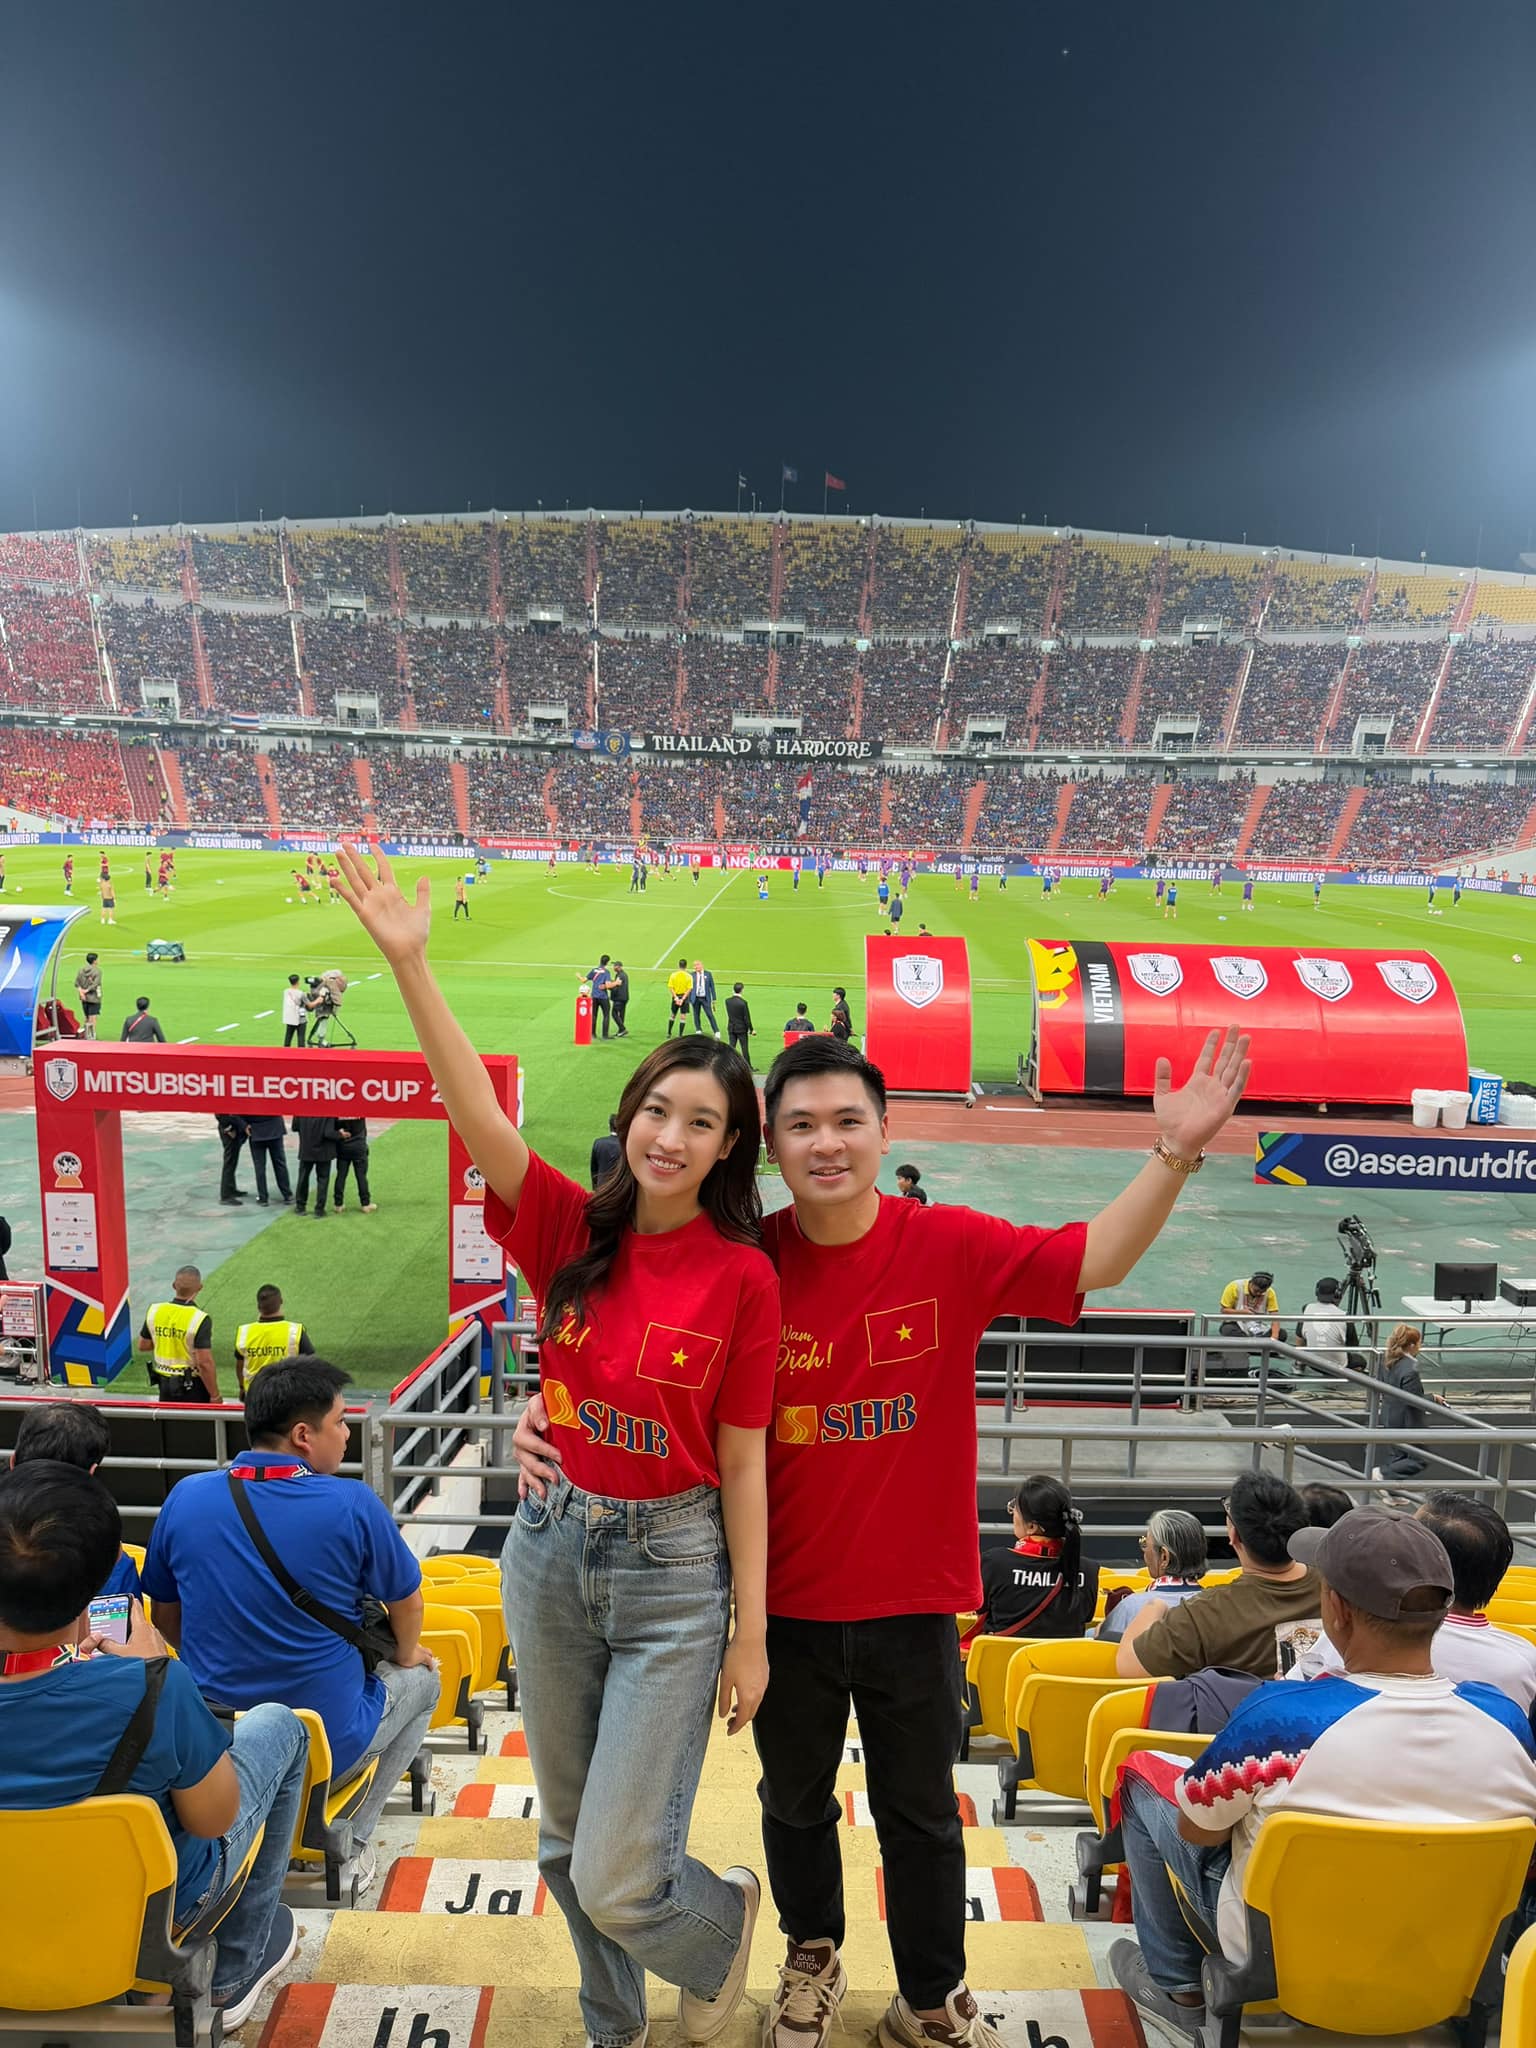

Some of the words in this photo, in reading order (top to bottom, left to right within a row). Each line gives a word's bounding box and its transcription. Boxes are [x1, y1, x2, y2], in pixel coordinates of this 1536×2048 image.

[651, 734, 751, 755] THAILAND
[775, 738, 873, 760] HARDCORE
[90, 833, 116, 845] ASEAN
[117, 834, 146, 846] UNITED
[146, 835, 157, 847] FC
[195, 837, 221, 848] ASEAN
[222, 838, 251, 849] UNITED
[251, 839, 263, 850] FC
[302, 841, 328, 852] ASEAN
[359, 843, 369, 854] FC
[408, 846, 434, 857] ASEAN
[435, 846, 464, 858] UNITED
[464, 847, 475, 858] FC
[512, 849, 537, 860] ASEAN
[568, 850, 578, 861] FC
[833, 860, 857, 871] ASEAN
[1070, 866, 1099, 877] UNITED
[1100, 867, 1111, 878] FC
[1150, 868, 1178, 879] ASEAN
[1179, 868, 1208, 880] UNITED
[1256, 870, 1283, 881] ASEAN
[1284, 871, 1313, 882] UNITED
[1367, 874, 1393, 885] ASEAN
[1394, 874, 1426, 886] UNITED
[1464, 878, 1481, 890] ASEAN
[1087, 963, 1114, 1023] VIETNAM
[84, 1069, 225, 1098] MITSUBISHI
[231, 1075, 355, 1101] ELECTRIC
[1481, 1081, 1491, 1120] SWEAT
[1488, 1081, 1499, 1123] POCARI
[246, 1345, 287, 1358] SECURITY
[821, 1392, 918, 1443] SHB
[577, 1398, 669, 1459] SHB
[796, 1952, 816, 1962] LOUIS
[793, 1959, 821, 1971] VUITTON
